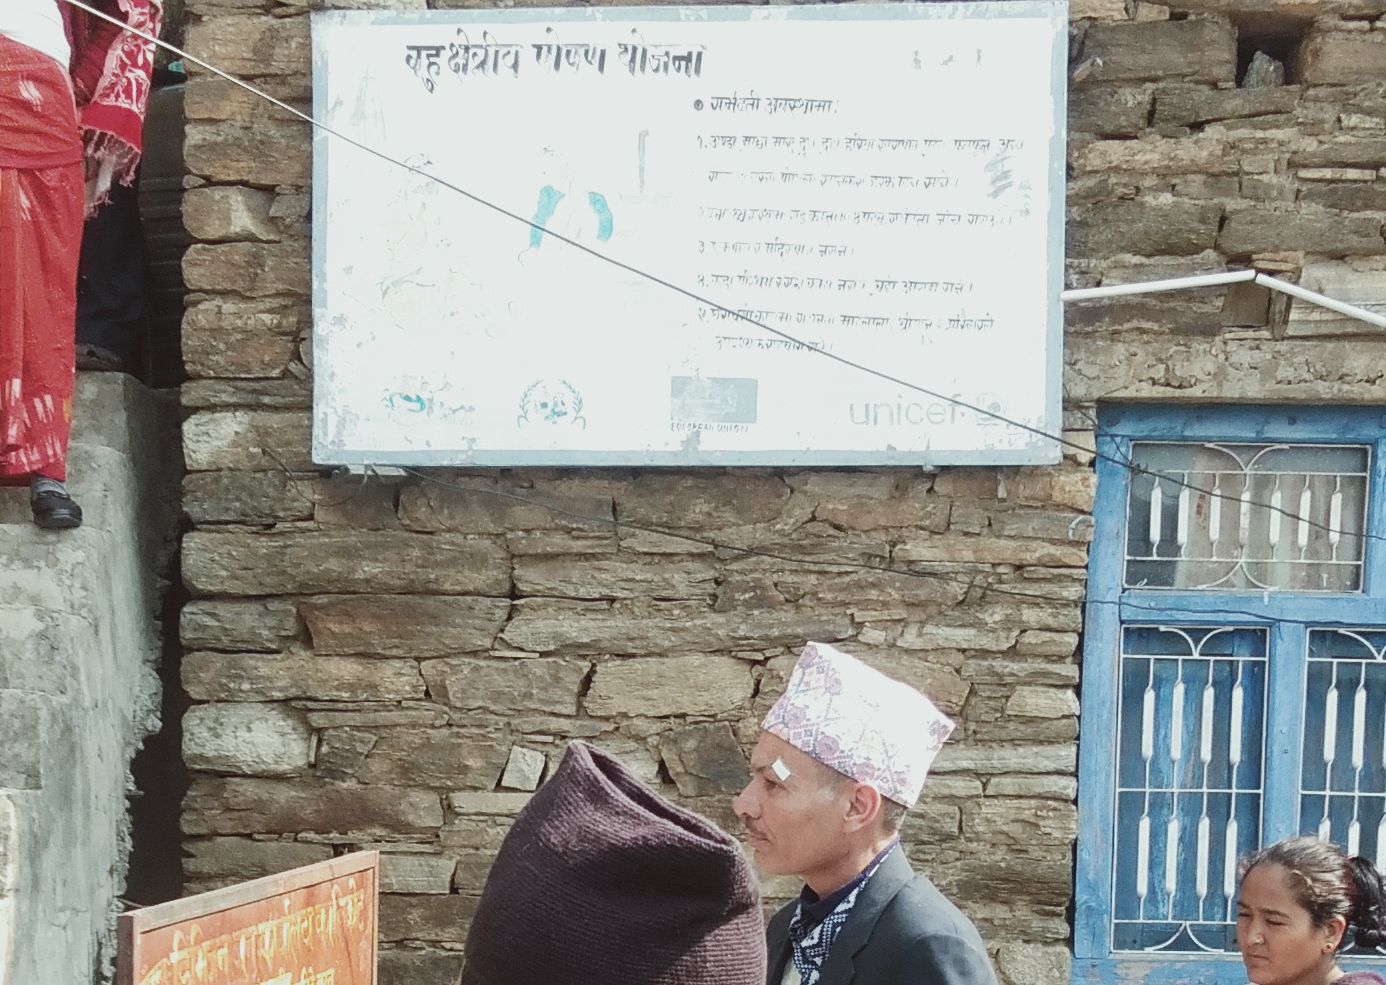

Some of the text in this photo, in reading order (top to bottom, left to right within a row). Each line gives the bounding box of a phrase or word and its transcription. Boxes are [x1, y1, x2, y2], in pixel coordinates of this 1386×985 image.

[617, 28, 707, 79] योजना
[849, 393, 963, 426] unicef
[717, 423, 749, 433] UNION
